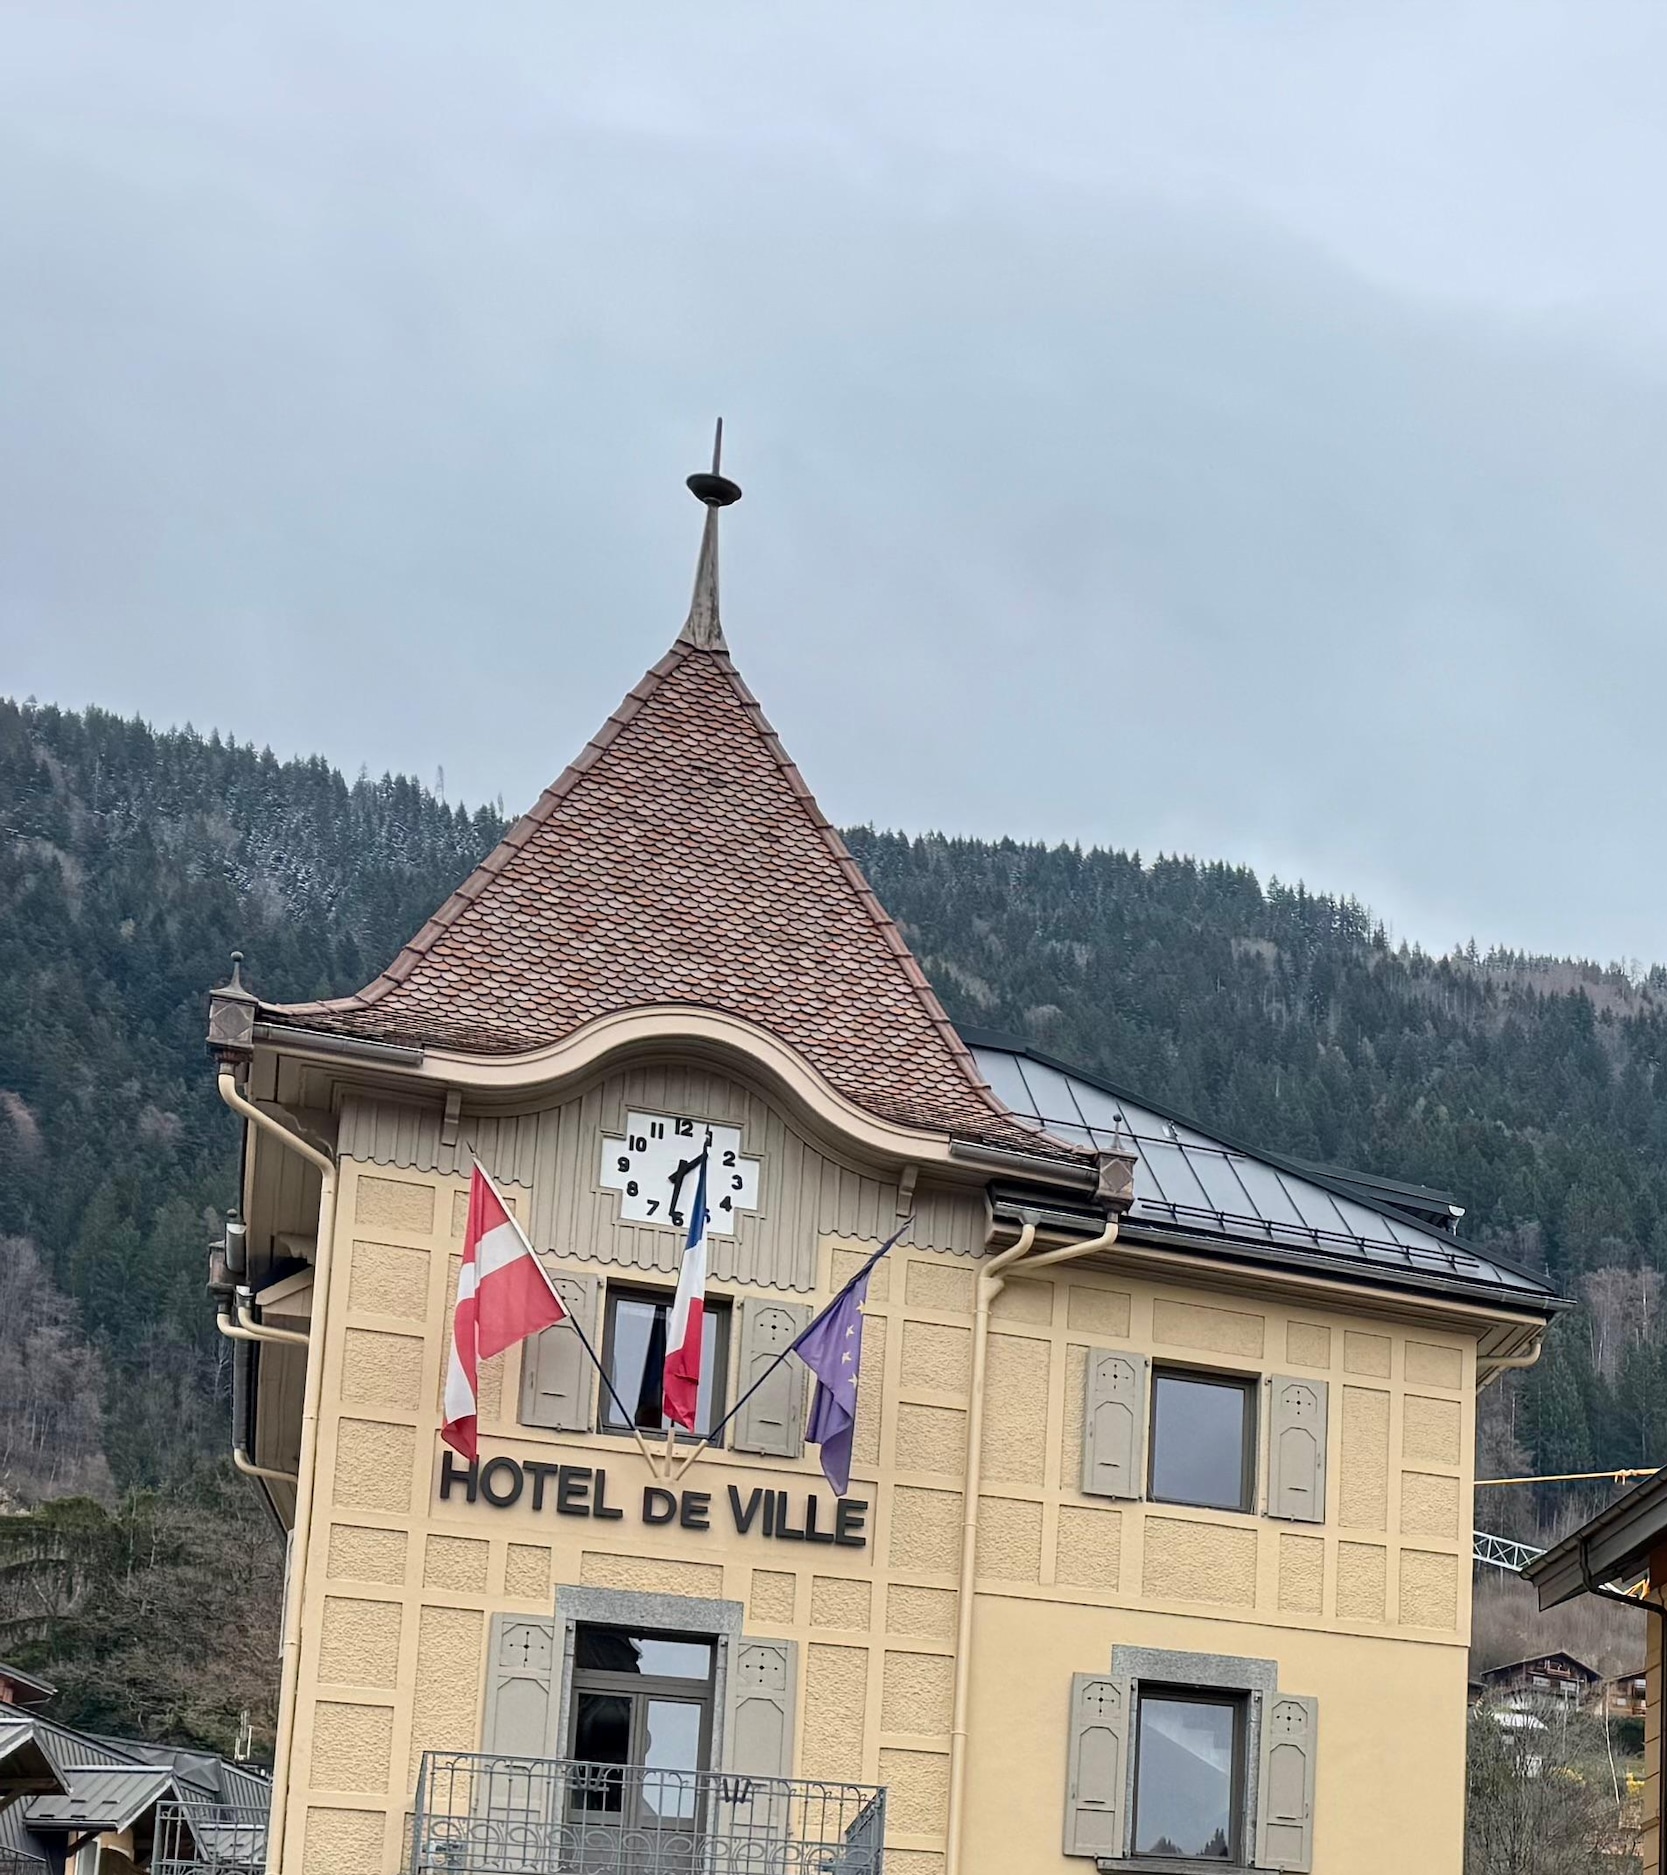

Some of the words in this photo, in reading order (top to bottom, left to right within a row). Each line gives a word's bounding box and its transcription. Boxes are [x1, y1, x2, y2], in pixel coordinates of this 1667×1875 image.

[650, 1122, 664, 1139] 11
[675, 1118, 694, 1138] 12
[628, 1135, 647, 1152] 10
[617, 1156, 630, 1172] 9
[722, 1151, 736, 1167] 2
[626, 1181, 639, 1197] 8
[731, 1174, 743, 1190] 3
[646, 1199, 660, 1216] 7
[719, 1195, 732, 1212] 4
[439, 1450, 623, 1519] HOTEL
[642, 1486, 712, 1529] DE
[727, 1484, 869, 1546] VILLE
